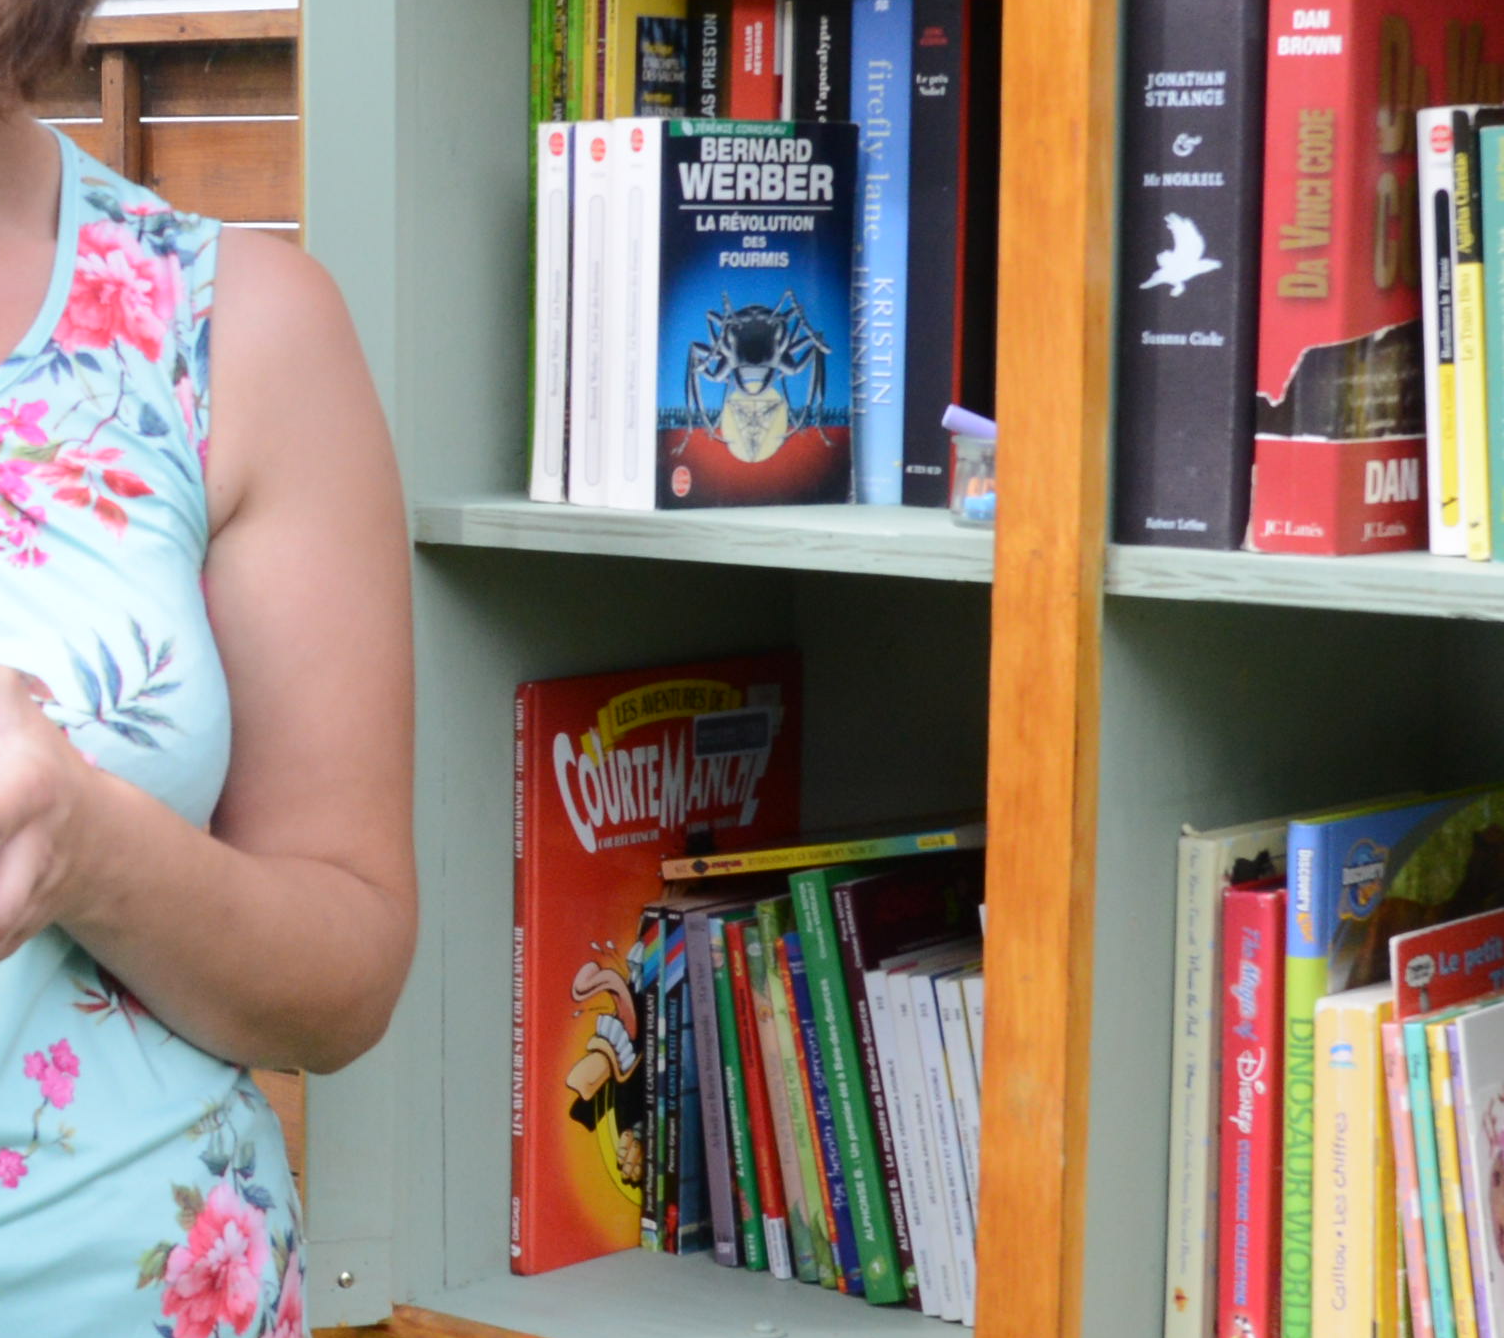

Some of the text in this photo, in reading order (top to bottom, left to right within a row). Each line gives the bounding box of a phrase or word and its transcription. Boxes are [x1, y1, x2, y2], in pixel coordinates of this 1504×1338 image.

[1293, 8, 1331, 30] DAN
[701, 12, 718, 89] PRESTON
[1277, 35, 1343, 56] BROWN
[1144, 70, 1226, 90] JONATHAN
[1144, 89, 1225, 107] STRANGE
[700, 138, 813, 163] BERNARD
[858, 57, 897, 242] firefly lane
[1172, 132, 1202, 157] &
[679, 164, 834, 202] WERBER
[1143, 172, 1225, 188] Mr NORRELL
[1276, 104, 1337, 302] DA VINCI CODE
[1453, 151, 1476, 253] Agatha Christie
[696, 212, 814, 232] LA RÉVOLUTION
[743, 236, 767, 249] DES
[719, 251, 790, 268] FOURMIS
[1141, 329, 1225, 348] Susanna Clarke
[1458, 272, 1475, 361] Le Train Bleu
[847, 266, 871, 415] HANNAH
[867, 276, 896, 405] KRISTIN
[1364, 457, 1419, 504] DAN
[1260, 519, 1283, 538] JC
[614, 686, 725, 727] LES AVENTURES DE
[552, 685, 783, 854] COURTEMANCHE
[1294, 849, 1316, 910] Discovery
[1239, 925, 1264, 959] The
[1439, 950, 1460, 975] Le
[1463, 934, 1504, 972] petit
[1230, 959, 1263, 1017] Magic
[510, 925, 524, 1135] LES AVENTURES DE COURTEMANCHE
[645, 993, 655, 1104] LE CAMEMBERT VOLANT
[669, 1034, 677, 1060] PETIT
[1236, 1018, 1261, 1039] of
[668, 1064, 677, 1097] GENTIL
[668, 1100, 676, 1110] LE
[815, 977, 876, 1243] ALPHONSE B. Un premier été à Baie-des-Sources
[854, 999, 910, 1252] ALPHONSE B. Le mystère de Baie-des-Sources
[1282, 1017, 1316, 1199] DINOSAUR
[812, 1091, 849, 1210] Pas besoin des
[884, 1058, 922, 1226] SÉLECTION BETTY ET VÉRONICA DOUBLE
[1234, 1139, 1253, 1220] STORYBOOK
[509, 1196, 520, 1241] DARGAUD
[1329, 1110, 1349, 1312] Caillou Les chiffres
[1231, 1223, 1250, 1306] COLLECTION
